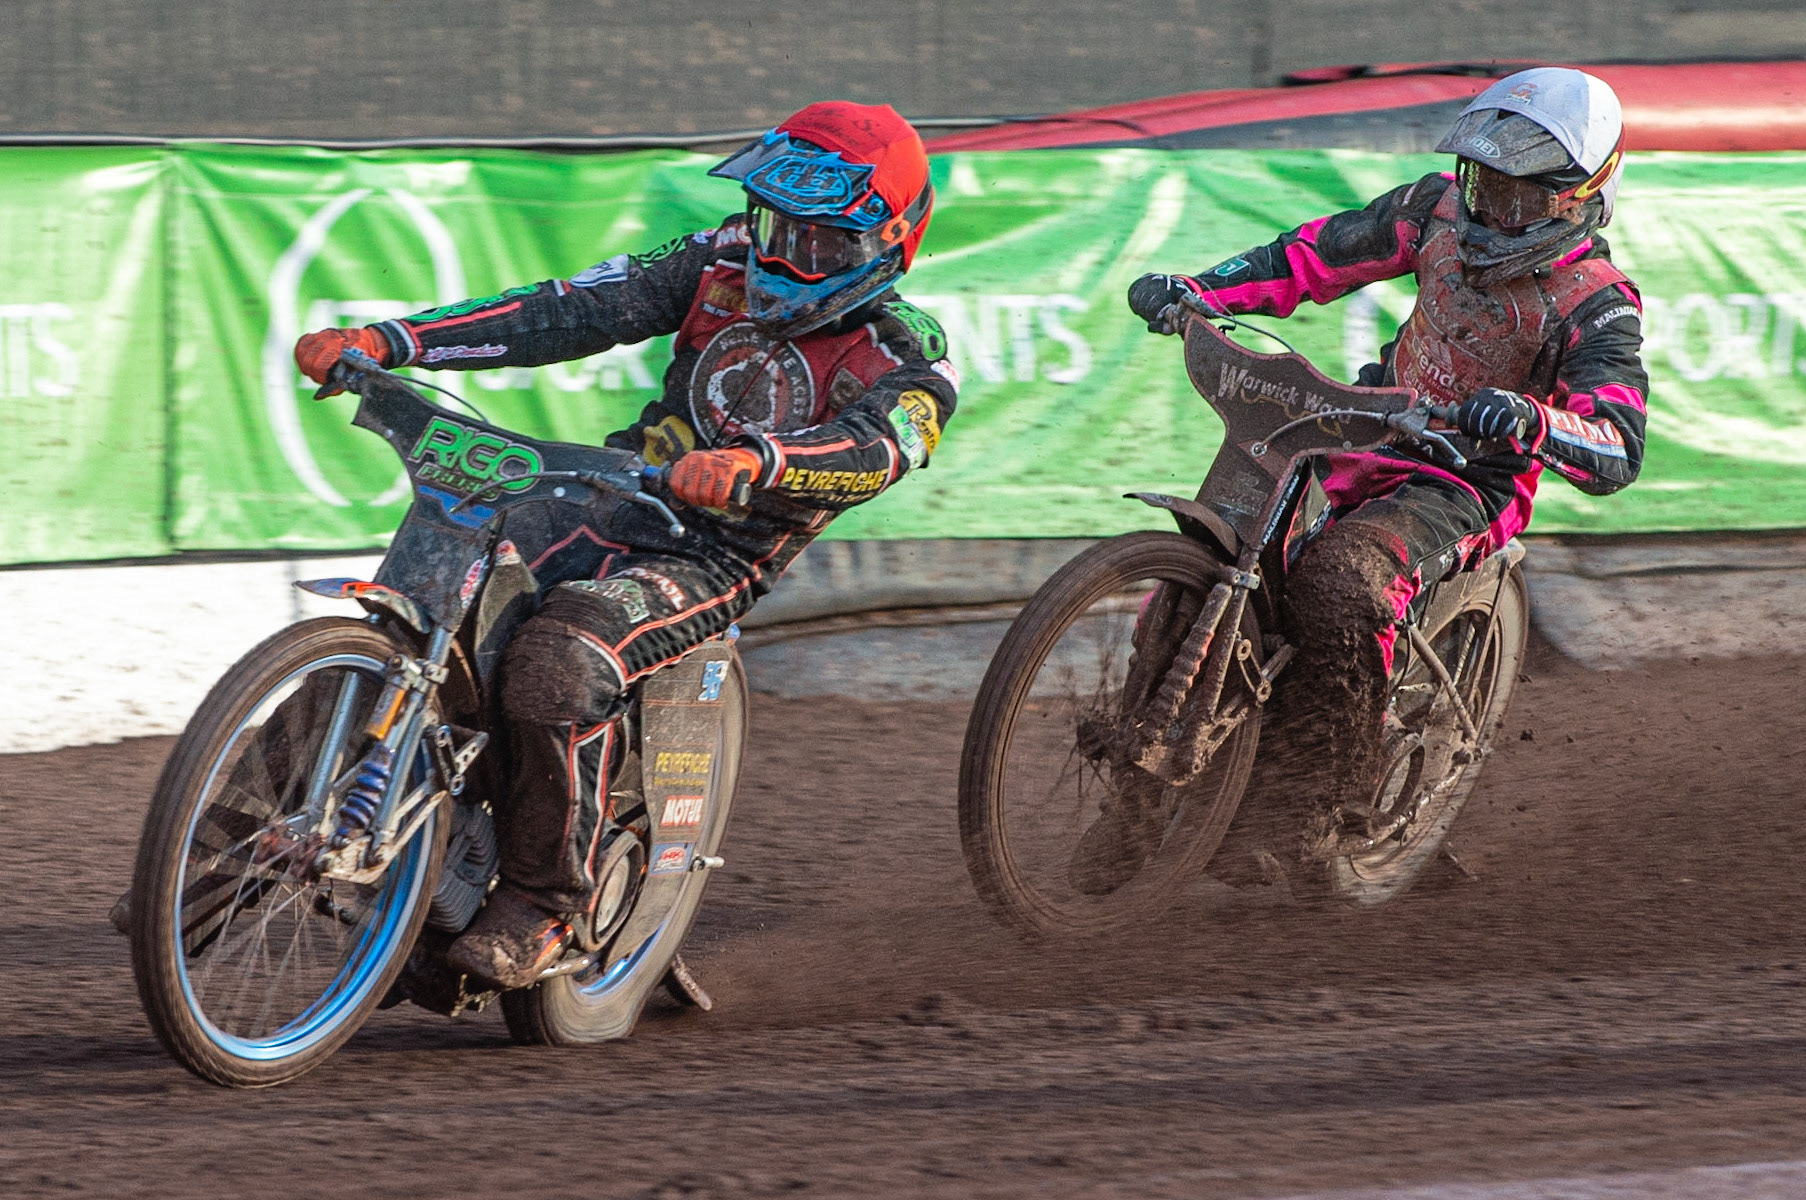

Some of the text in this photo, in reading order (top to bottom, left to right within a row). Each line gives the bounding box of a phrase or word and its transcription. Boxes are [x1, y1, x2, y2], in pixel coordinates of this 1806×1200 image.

[1217, 362, 1299, 405] Warwick
[407, 415, 546, 494] RIGO
[662, 797, 703, 825] MOTUL
